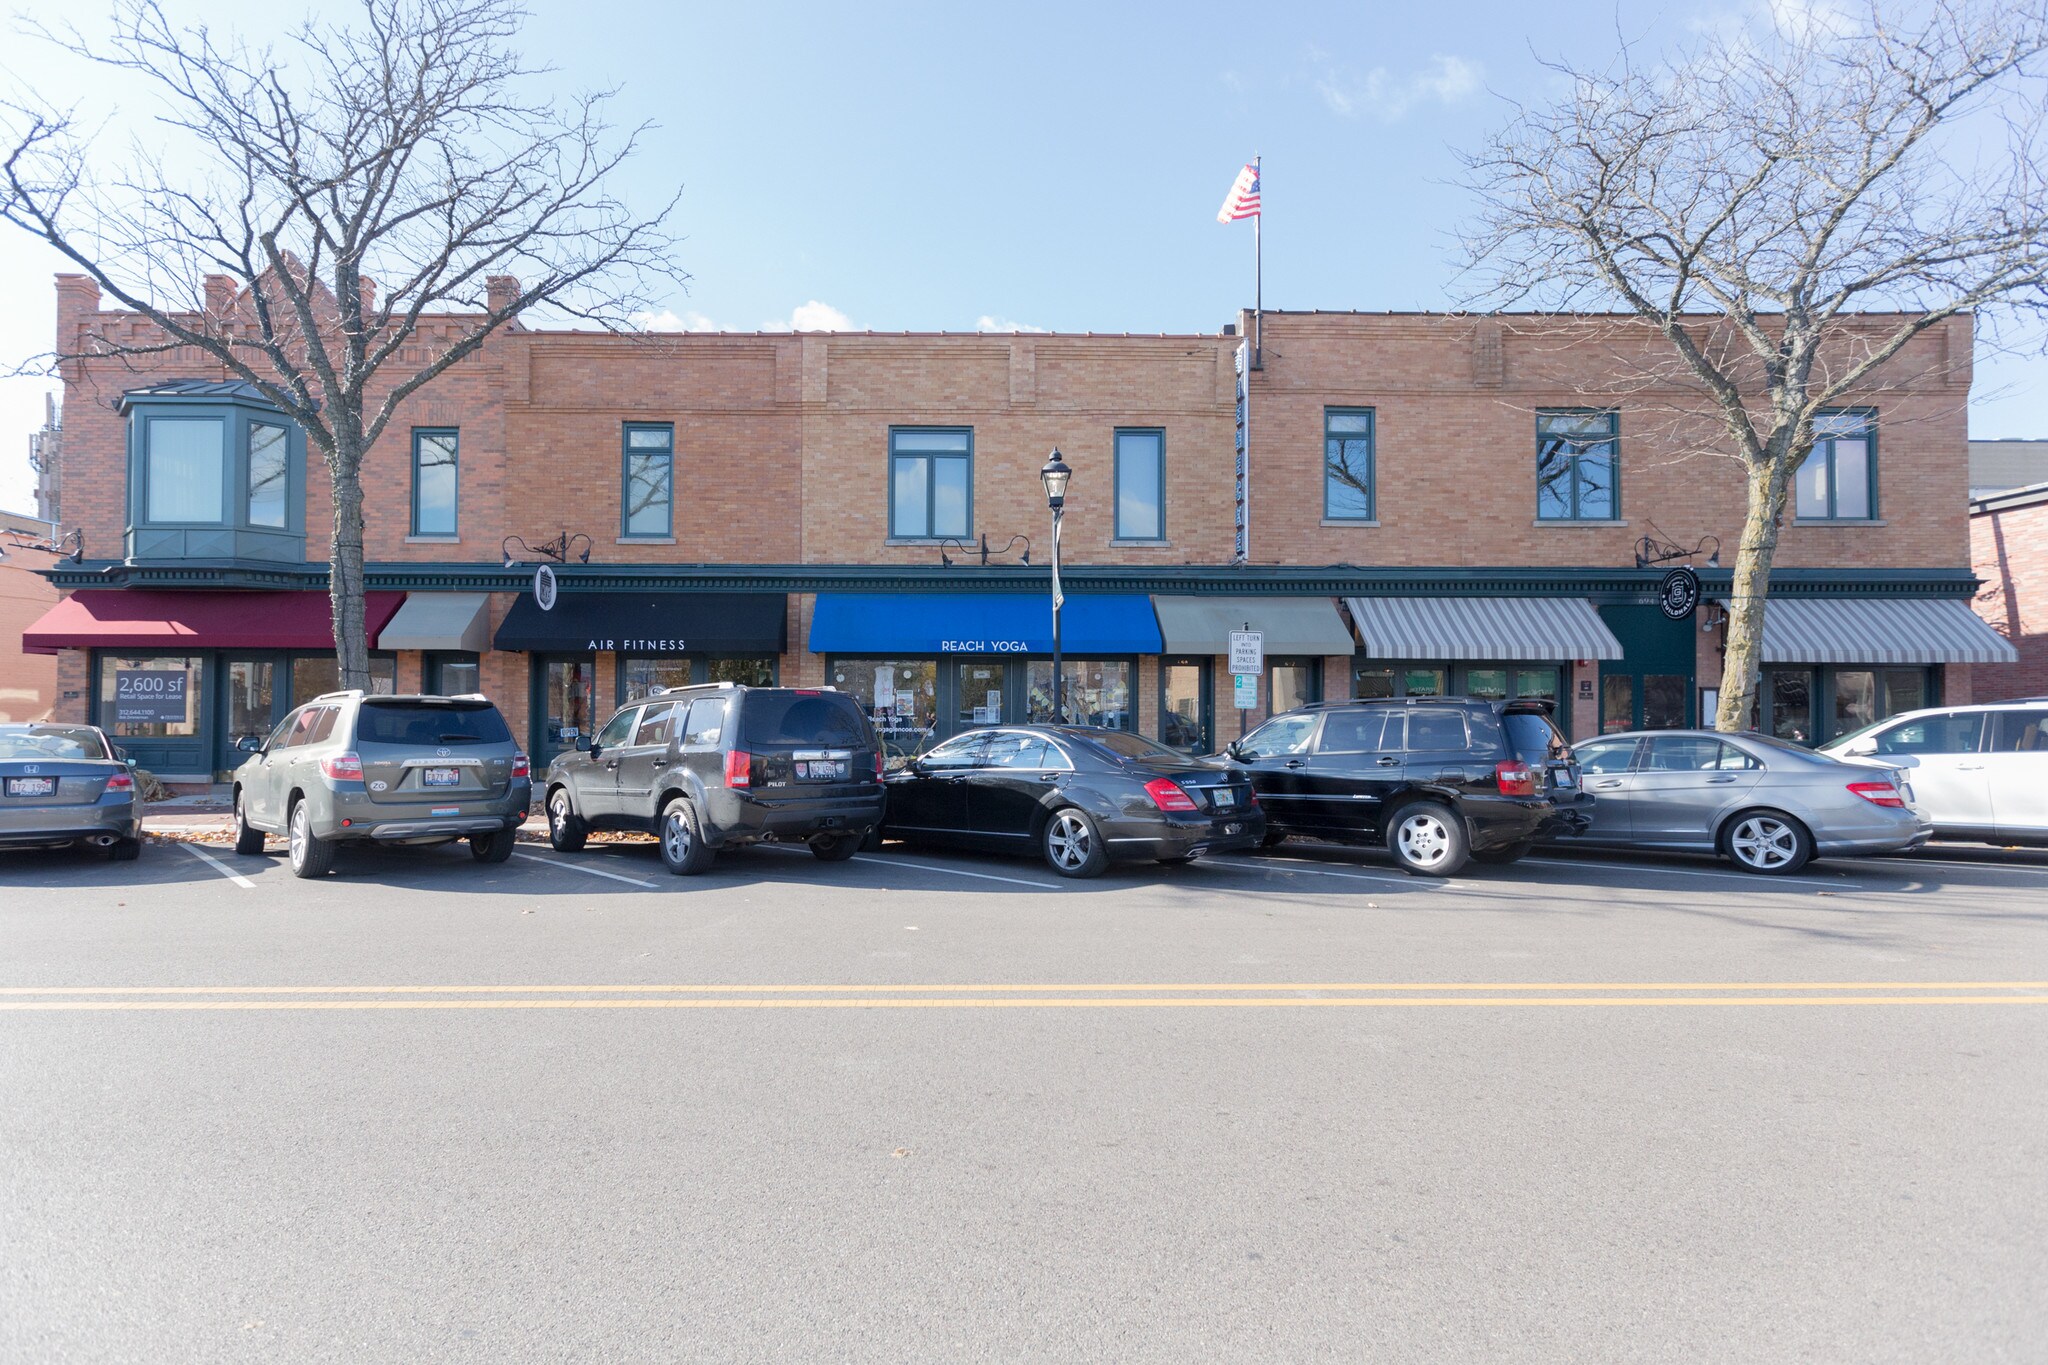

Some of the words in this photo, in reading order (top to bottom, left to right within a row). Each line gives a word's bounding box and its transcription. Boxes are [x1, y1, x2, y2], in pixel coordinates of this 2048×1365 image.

[1663, 596, 1692, 616] GUILDHALL
[588, 640, 614, 650] AIR
[624, 640, 685, 650] FITNESS
[942, 641, 984, 651] REACH
[991, 641, 1028, 651] YOGA
[120, 678, 163, 693] 2,600
[168, 677, 184, 692] sf
[1236, 677, 1242, 686] 2
